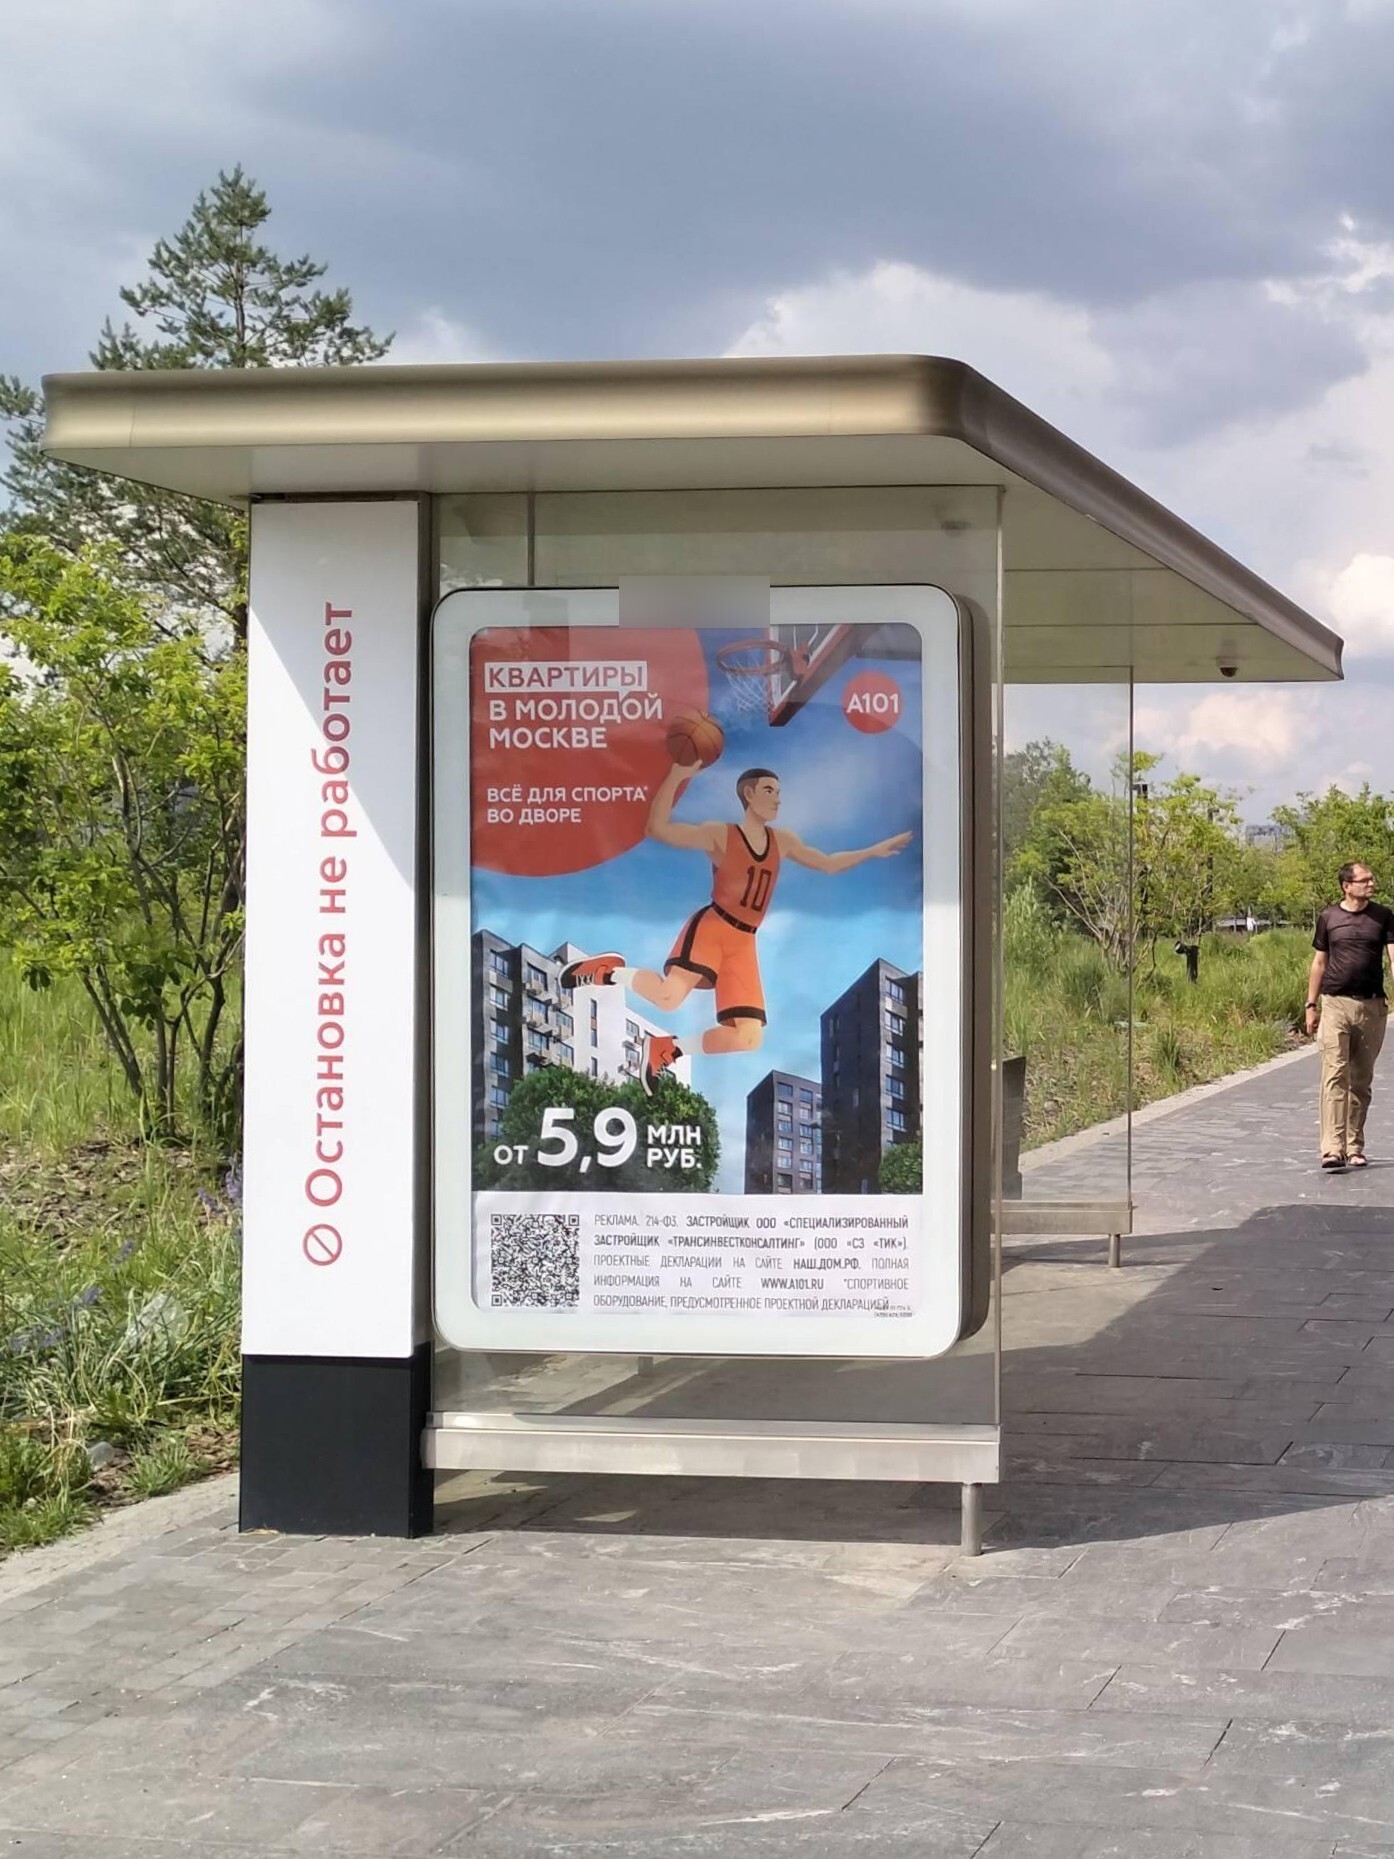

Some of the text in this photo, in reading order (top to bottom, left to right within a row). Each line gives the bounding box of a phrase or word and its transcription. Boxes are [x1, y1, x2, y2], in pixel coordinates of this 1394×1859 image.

[489, 666, 643, 688] КВАРТИРЫ
[489, 693, 663, 723] В МОЛОДОЙ
[489, 727, 608, 749] МОСКВЕ
[487, 784, 523, 803] ВСЁ
[527, 787, 566, 804] ДЛЯ
[487, 808, 582, 825] ВО ДВОРЕ
[740, 865, 772, 912] 10
[305, 602, 357, 1207] Остановка не работает
[537, 1107, 637, 1173] 5,9
[647, 1125, 701, 1145] МЛН
[646, 1148, 702, 1169] РУБ.
[686, 1214, 750, 1229] ЗАСТРОЙЩИК
[756, 1217, 777, 1229] ООО
[783, 1215, 909, 1230] «СПЕЦИАЛИЗИРОВАННЫЙ
[594, 1233, 660, 1247] ЗАСТРОЙЩИК
[667, 1235, 805, 1249] «ТРАНСИНВЕСТКОНСАЛТИНГ»
[814, 1236, 838, 1251] (ООО
[846, 1237, 865, 1249] «СЗ
[593, 1254, 650, 1267] ПРОЕКТНЫЕ
[660, 1256, 722, 1269] ДЕКЛАРАЦИИ
[733, 1257, 746, 1268] НА
[755, 1255, 783, 1269] САЙТЕ
[872, 1257, 909, 1269] ПОЛНАЯ
[593, 1274, 660, 1287] ИНФОРМАЦИЯ
[679, 1276, 692, 1287] НА
[712, 1274, 742, 1288] САЙТЕ
[670, 1296, 762, 1309] ПРЕДУСМОТРЕННОЕ
[764, 1296, 819, 1310] ПРОЕКТНОЙ
